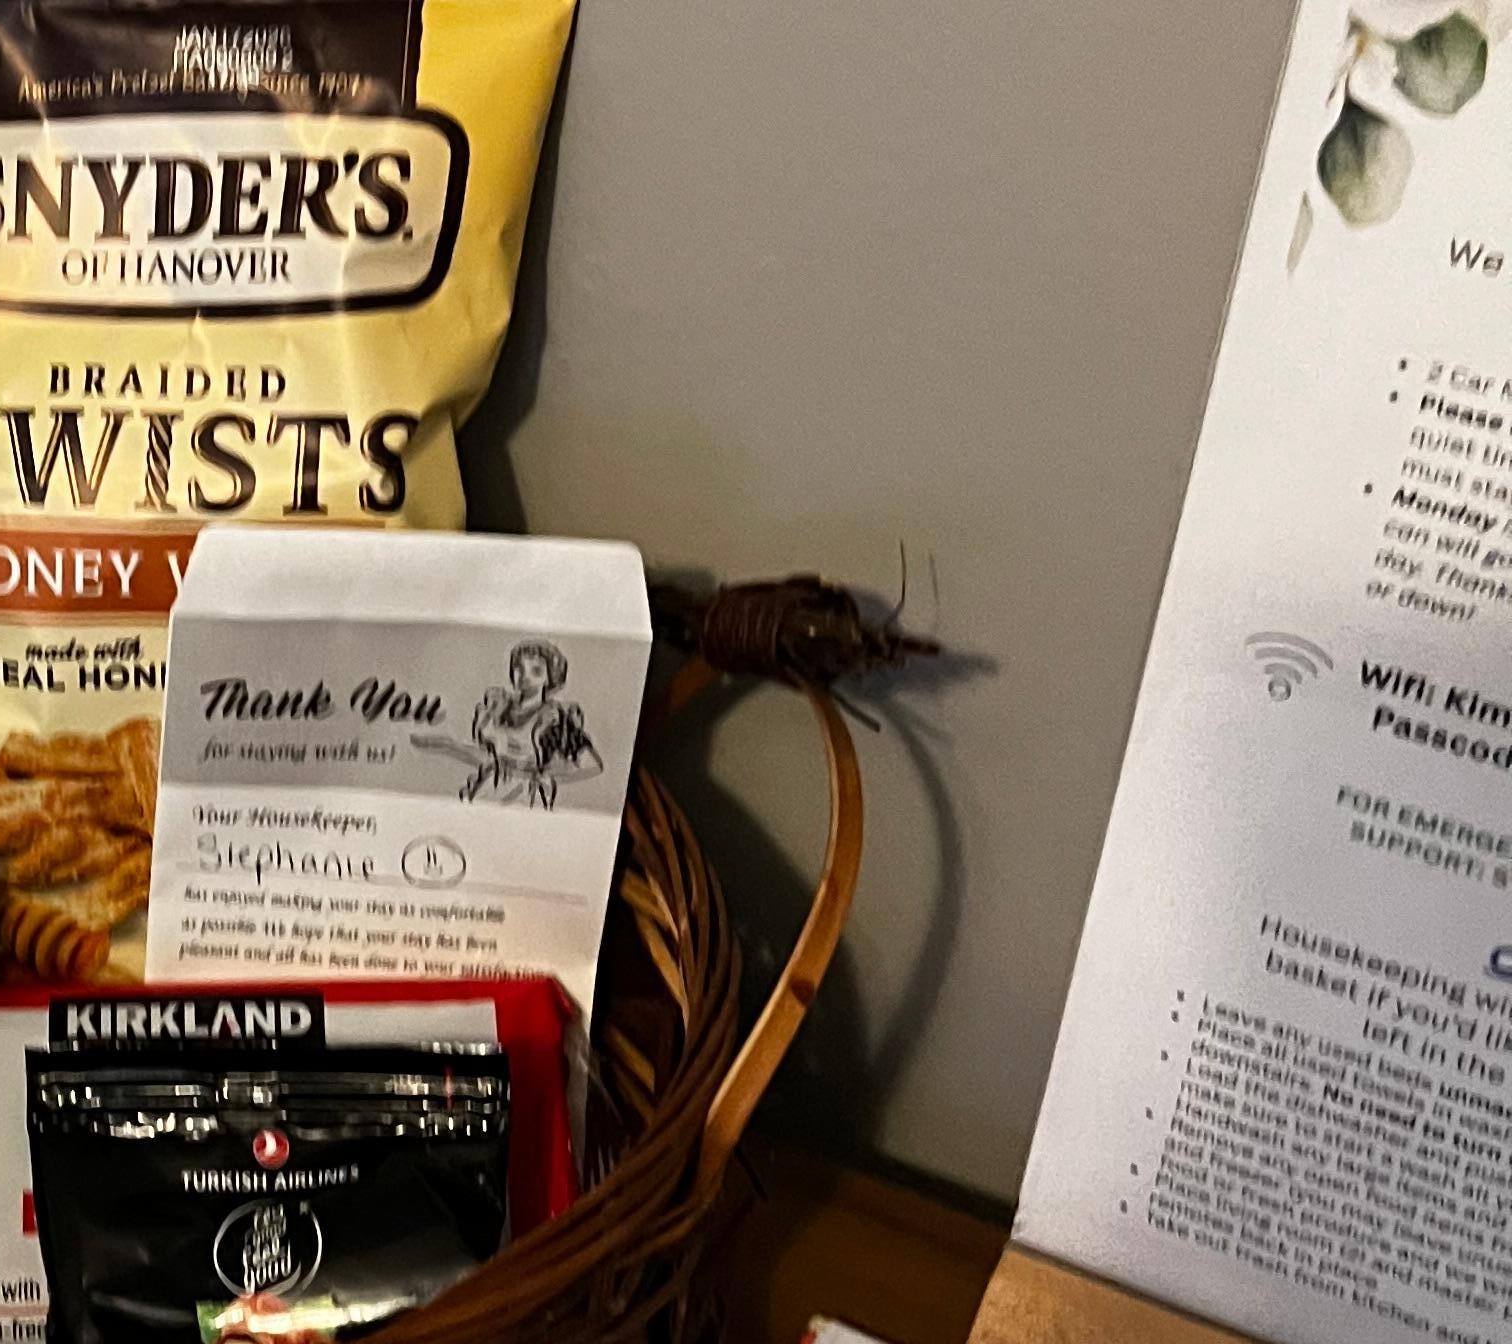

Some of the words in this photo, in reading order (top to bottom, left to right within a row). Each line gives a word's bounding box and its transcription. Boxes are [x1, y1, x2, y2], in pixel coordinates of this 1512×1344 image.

[62, 250, 109, 285] OF
[123, 247, 293, 286] HANOVER
[49, 362, 287, 400] BRAIDED
[1392, 486, 1498, 534] Monday
[201, 677, 336, 723] Thank
[350, 676, 447, 725] You
[314, 742, 360, 764] with
[196, 832, 375, 886] Stephanie
[1260, 915, 1466, 1008] Housekeeping
[66, 1002, 314, 1041] KIRKLAND
[181, 1169, 267, 1192] TURKISH
[274, 1163, 360, 1191] AIRLINES
[1, 1277, 41, 1303] with
